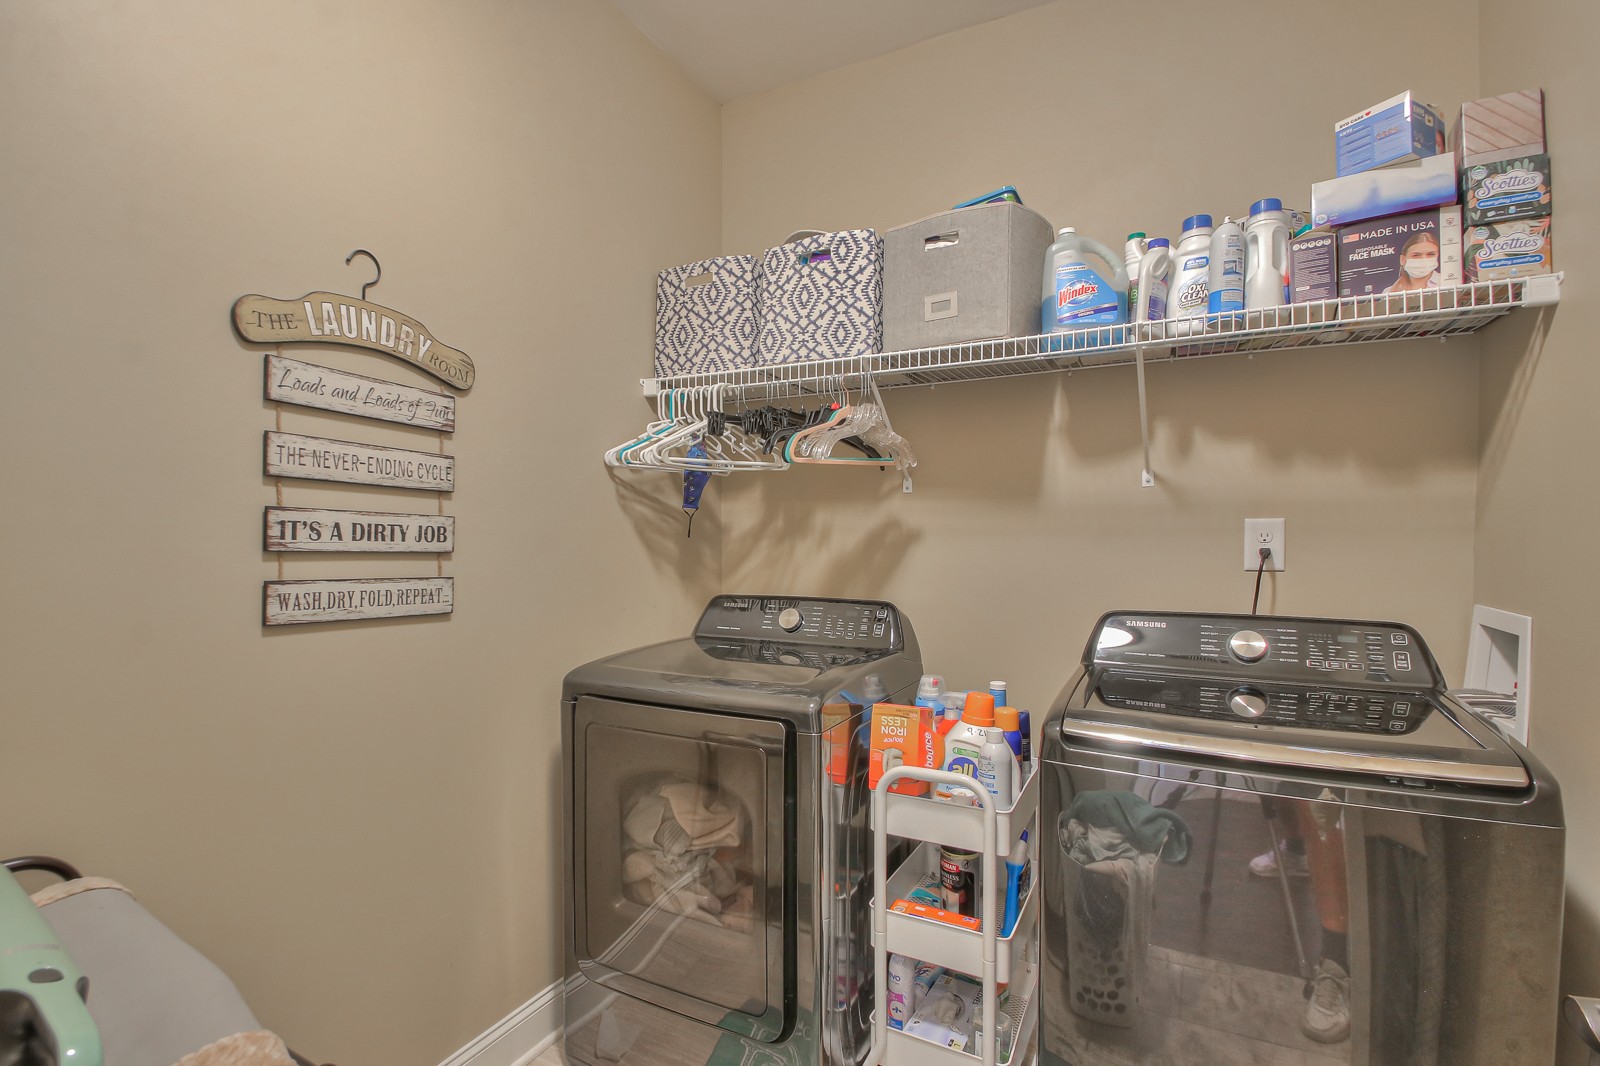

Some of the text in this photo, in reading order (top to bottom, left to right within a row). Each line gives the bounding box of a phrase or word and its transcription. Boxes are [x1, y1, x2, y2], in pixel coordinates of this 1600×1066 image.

[1476, 175, 1537, 197] Scotties
[1479, 192, 1540, 207] everyday comfort
[1360, 221, 1435, 240] MADE IN USA
[1349, 247, 1395, 261] FACE MASK
[1355, 243, 1388, 254] DISPOSABLE
[1479, 237, 1538, 258] Scotties
[1481, 255, 1541, 268] everyday comfort
[1058, 285, 1098, 308] Windex
[1188, 284, 1206, 294] OXI
[252, 310, 298, 331] THE
[303, 301, 432, 361] LAUNDRY
[429, 352, 470, 384] ROOM
[278, 369, 452, 421] Loads and Loads of Fun
[276, 444, 452, 482] THE NEVER-ENDING CYCLE
[278, 519, 448, 543] IT'S A DIRTY JOB
[1126, 620, 1167, 628] SAMSUNG
[881, 715, 908, 727] LESS
[881, 725, 908, 736] IRON
[925, 731, 933, 768] bounce
[952, 763, 974, 778] all
